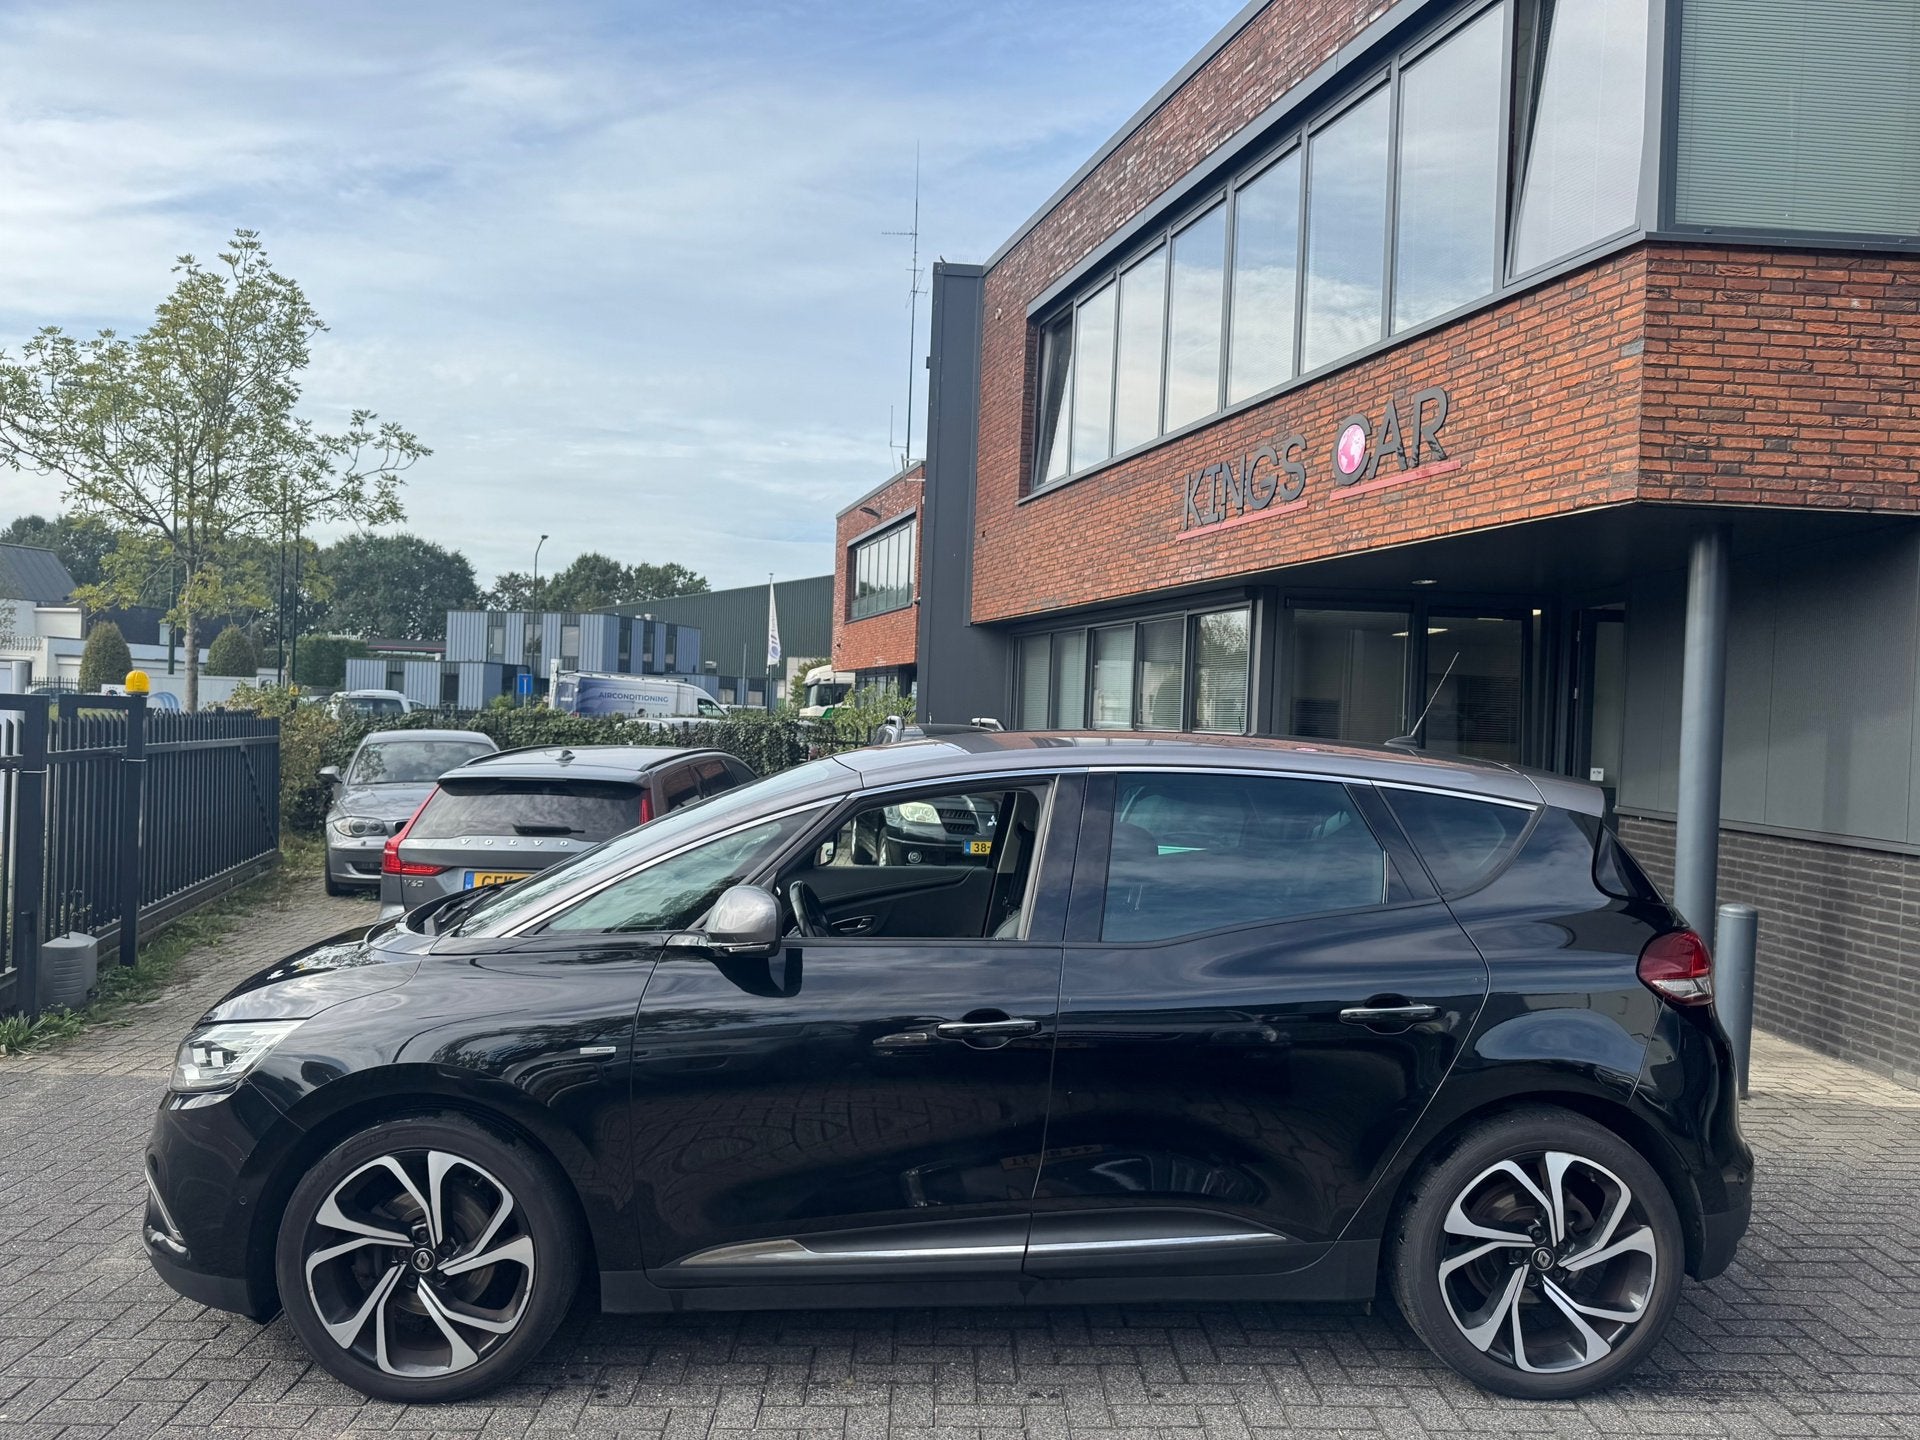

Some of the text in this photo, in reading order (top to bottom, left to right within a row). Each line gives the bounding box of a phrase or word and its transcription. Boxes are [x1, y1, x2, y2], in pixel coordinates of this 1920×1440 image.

[1183, 386, 1448, 531] KINGS CAR
[599, 691, 669, 703] AIRCONDITIONING
[461, 838, 568, 847] VOLVO
